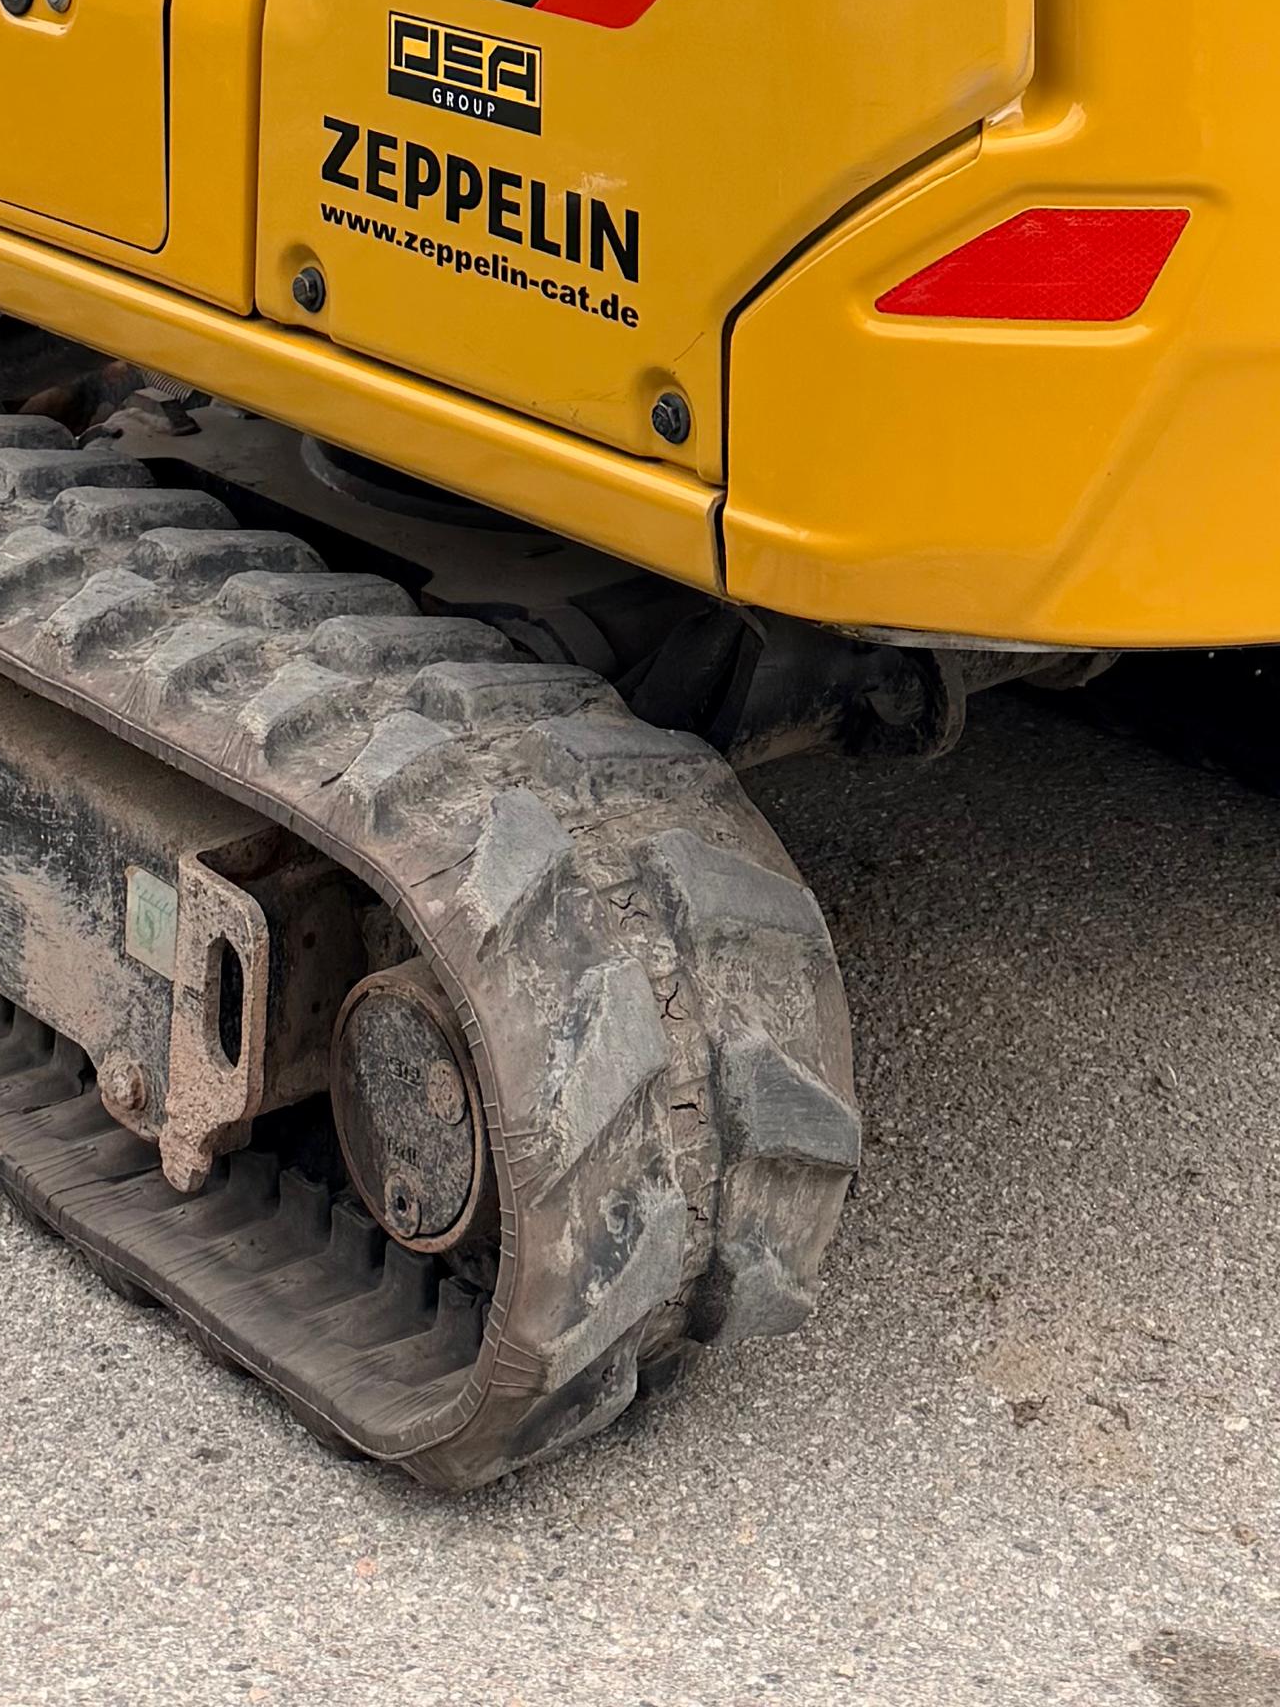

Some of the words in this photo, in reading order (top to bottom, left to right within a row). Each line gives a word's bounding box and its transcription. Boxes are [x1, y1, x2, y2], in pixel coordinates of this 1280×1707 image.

[432, 88, 496, 118] GROUP
[321, 115, 639, 284] ZEPPELIN
[320, 203, 640, 328] www.zeppelin-cat.de
